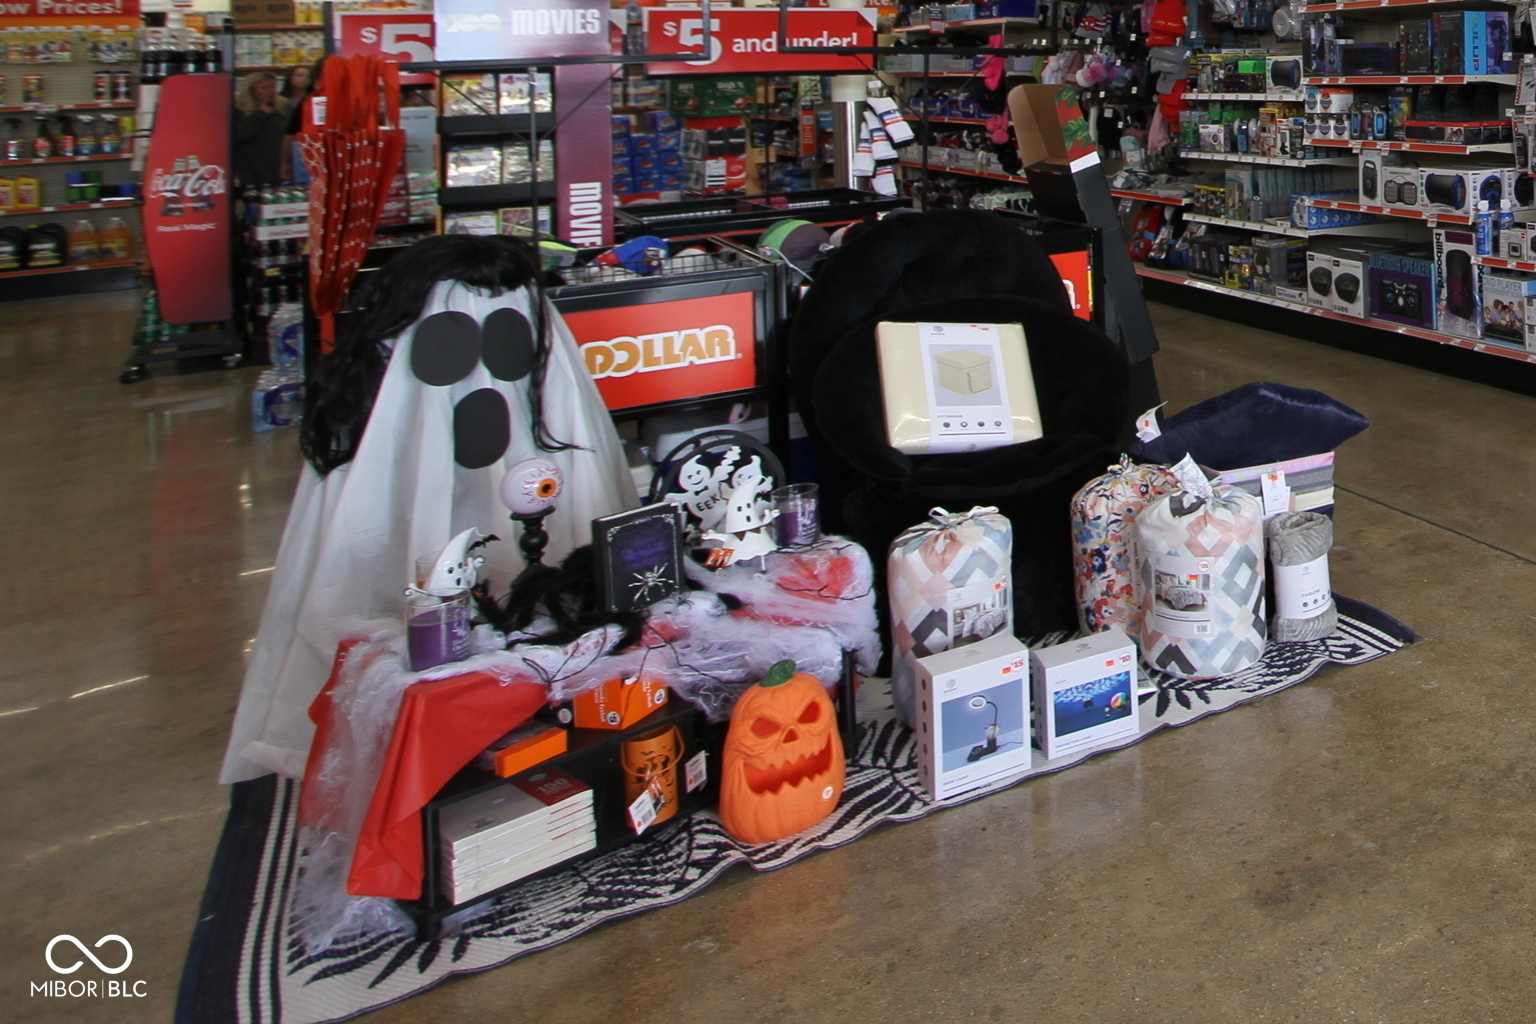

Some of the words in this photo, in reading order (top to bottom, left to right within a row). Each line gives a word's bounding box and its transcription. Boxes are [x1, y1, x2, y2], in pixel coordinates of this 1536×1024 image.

[0, 2, 31, 15] ow
[511, 8, 601, 36] MOVIES
[360, 23, 435, 77] $5
[662, 19, 723, 66] $5
[732, 31, 778, 53] and
[568, 181, 603, 249] MOVIE
[1368, 254, 1401, 273] BLUETOOTH
[1401, 259, 1431, 276] SPEAKER
[1434, 232, 1445, 288] billboard
[1496, 277, 1523, 290] PLAYER
[581, 326, 735, 378] DOLLAR
[695, 493, 721, 513] EEK
[1301, 588, 1321, 598] THROW
